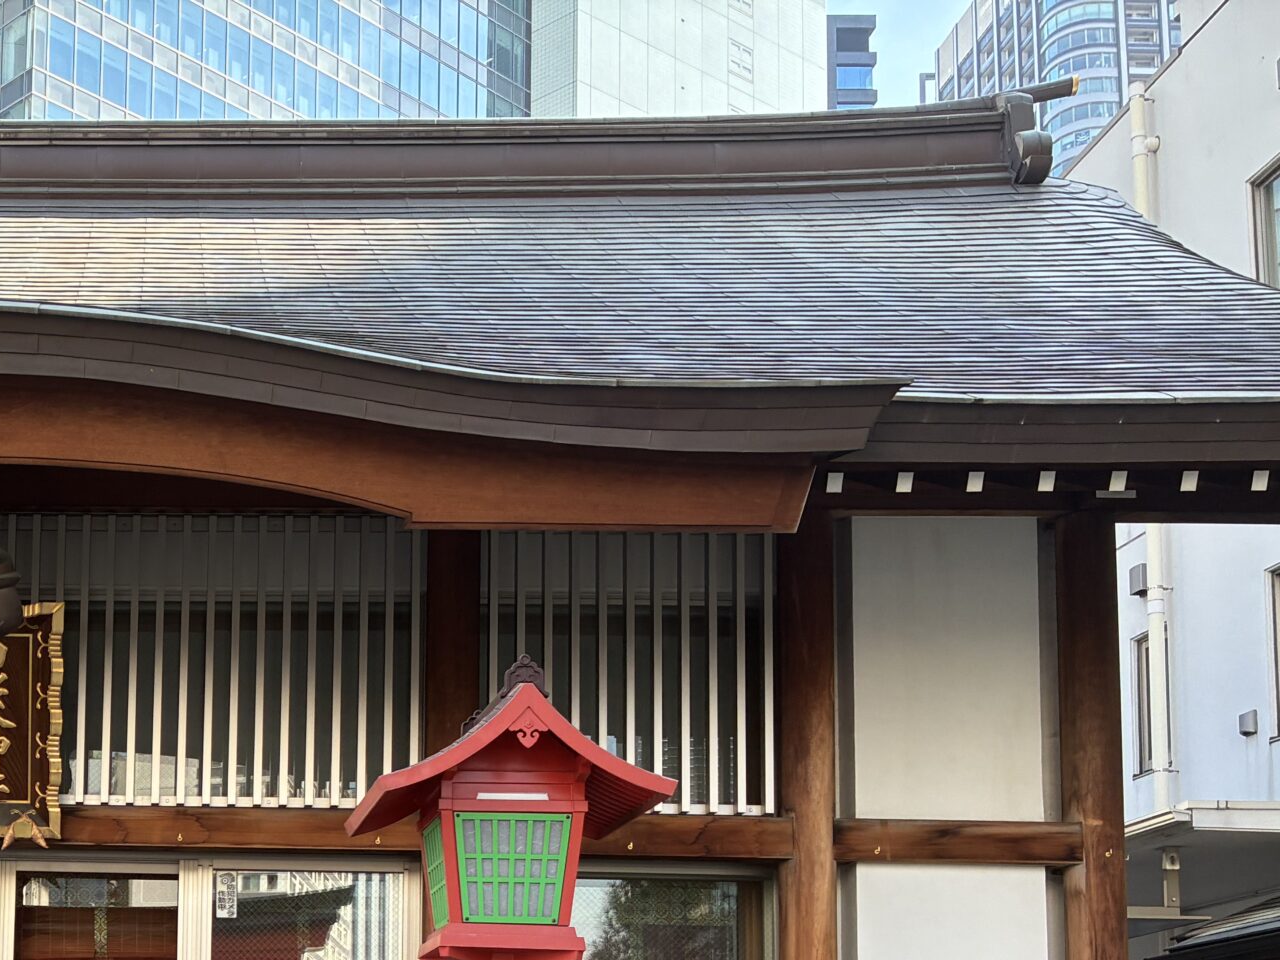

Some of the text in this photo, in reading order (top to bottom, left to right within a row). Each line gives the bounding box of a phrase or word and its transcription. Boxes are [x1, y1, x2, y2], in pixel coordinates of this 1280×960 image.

[218, 891, 226, 911] 作動中
[227, 884, 235, 916] 防犯カメラ
